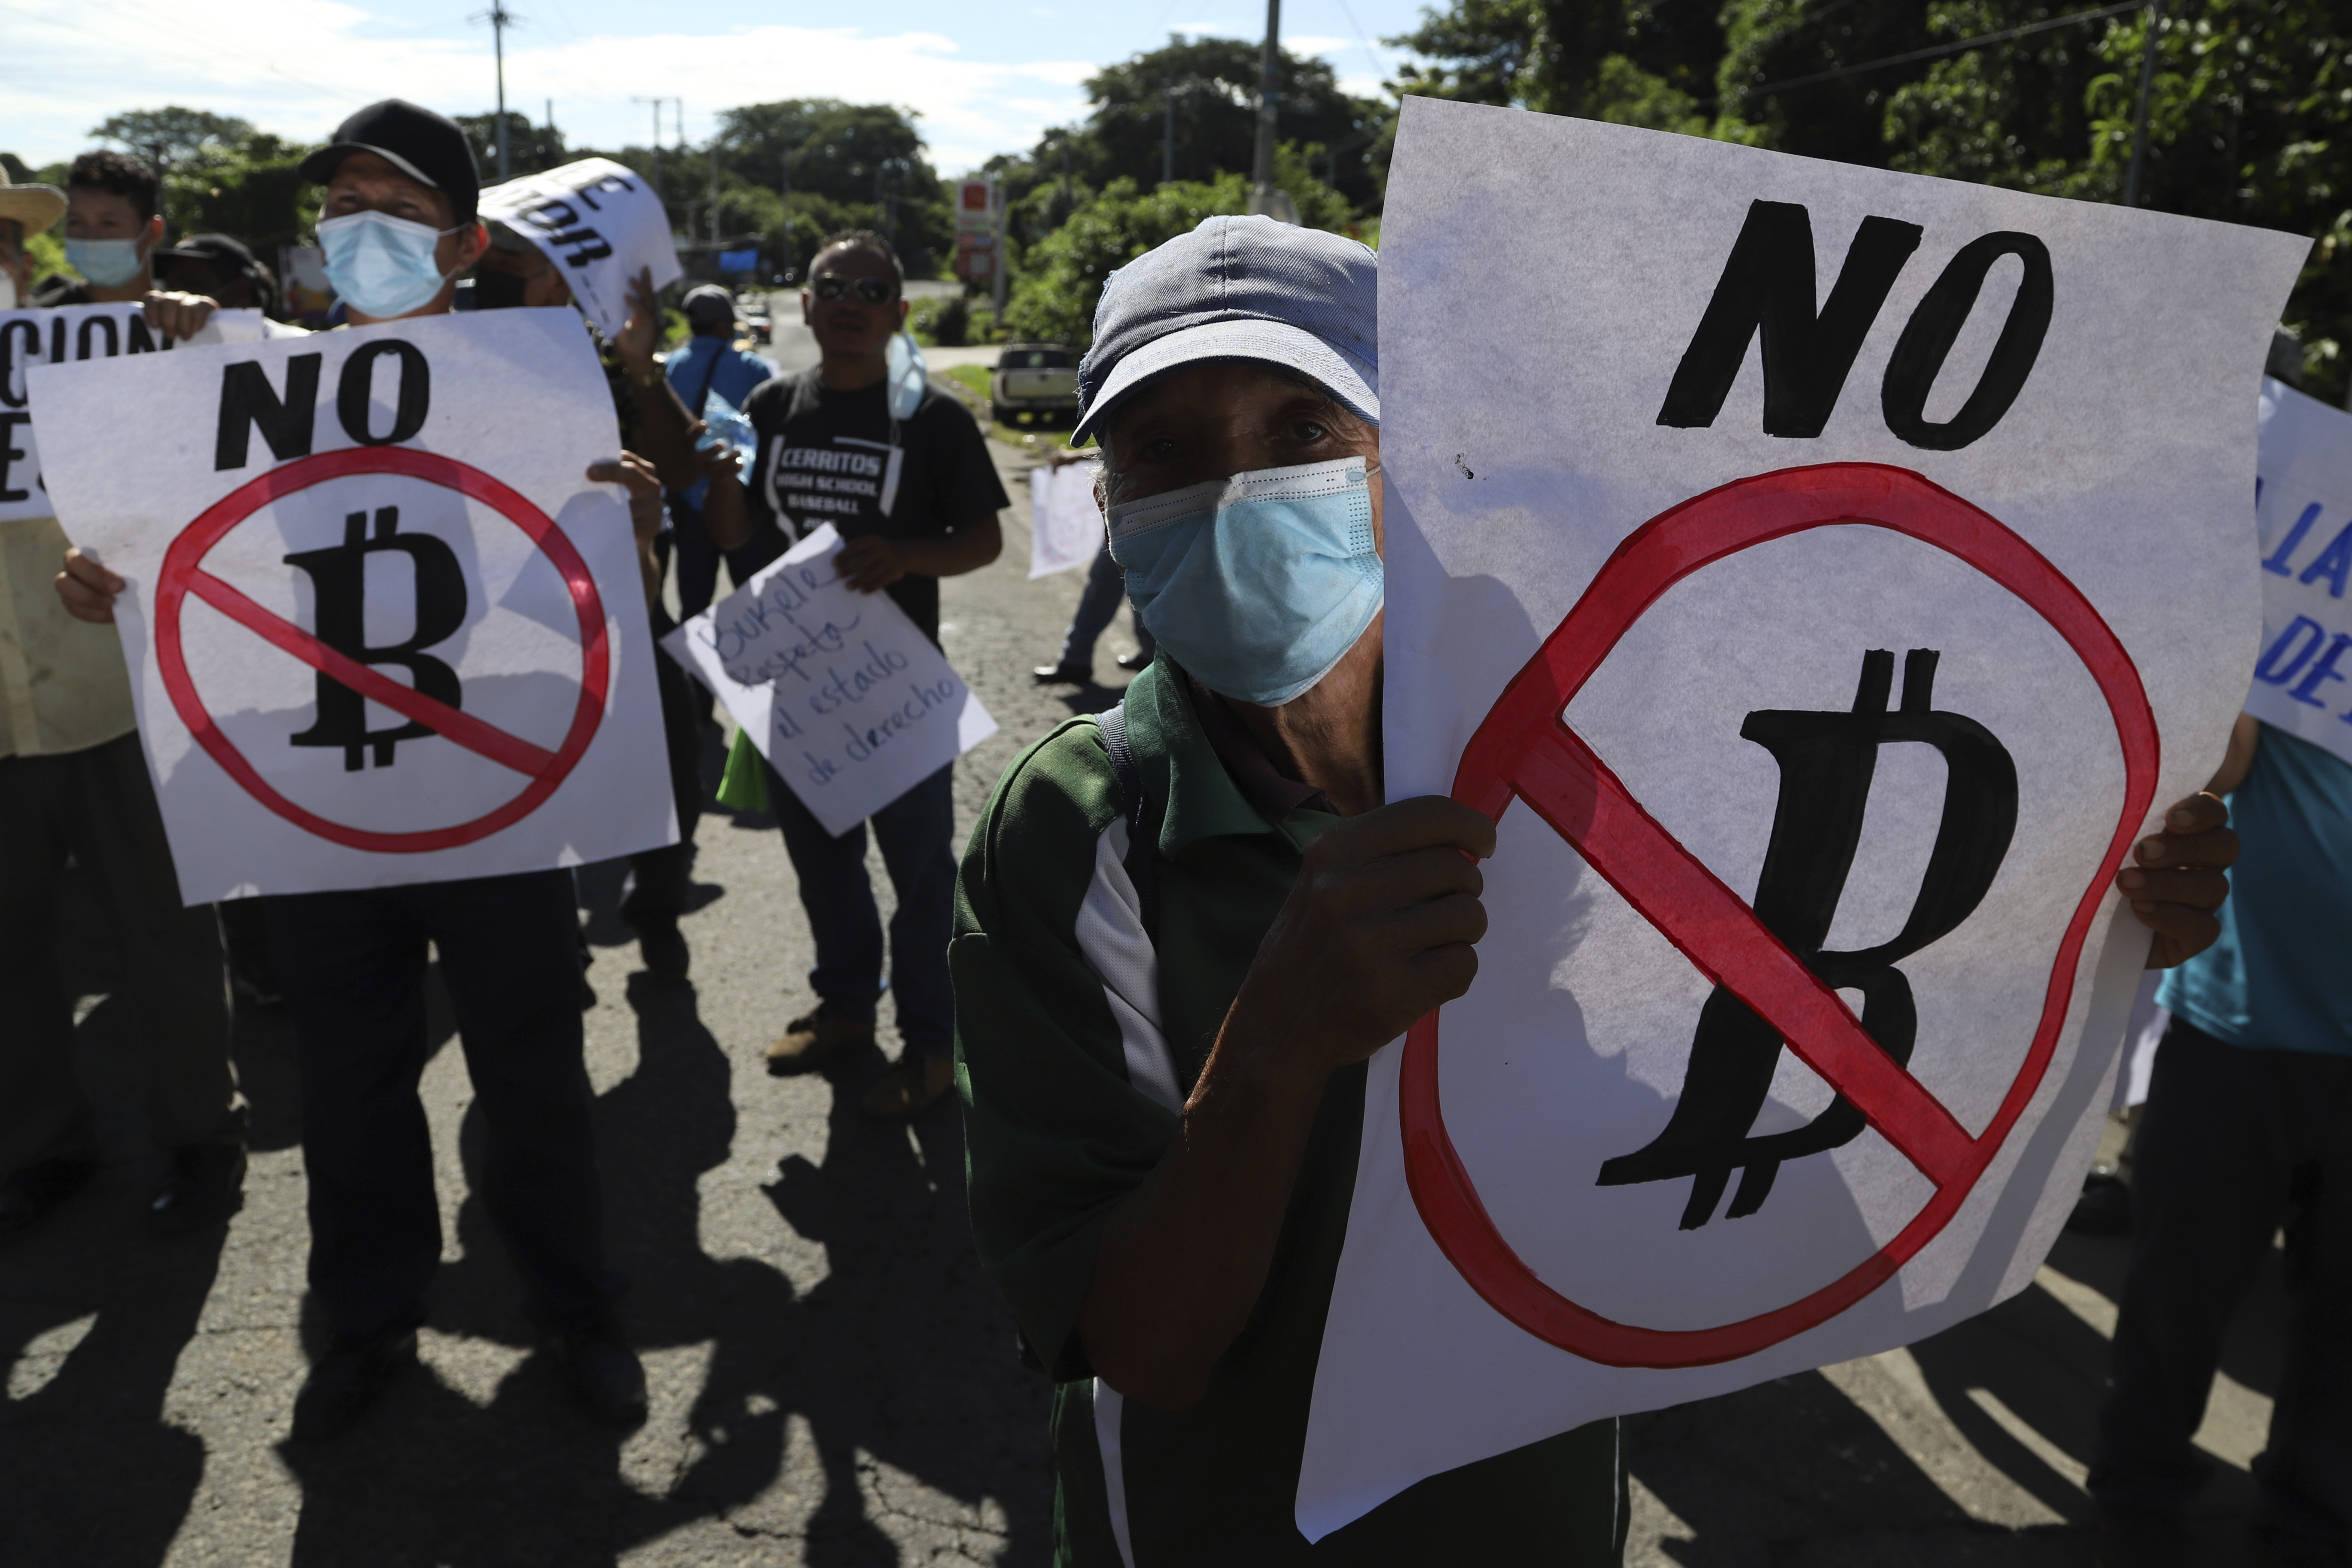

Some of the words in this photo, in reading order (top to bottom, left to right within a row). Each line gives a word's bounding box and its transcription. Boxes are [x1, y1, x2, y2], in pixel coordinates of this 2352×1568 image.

[1656, 199, 2054, 451] NO
[214, 338, 430, 471] NO
[780, 448, 882, 477] CERRITOS
[816, 475, 879, 497] SCHOOL
[777, 706, 804, 739] el
[808, 640, 909, 715] estado
[807, 751, 844, 786] de
[844, 678, 954, 762] derecho
